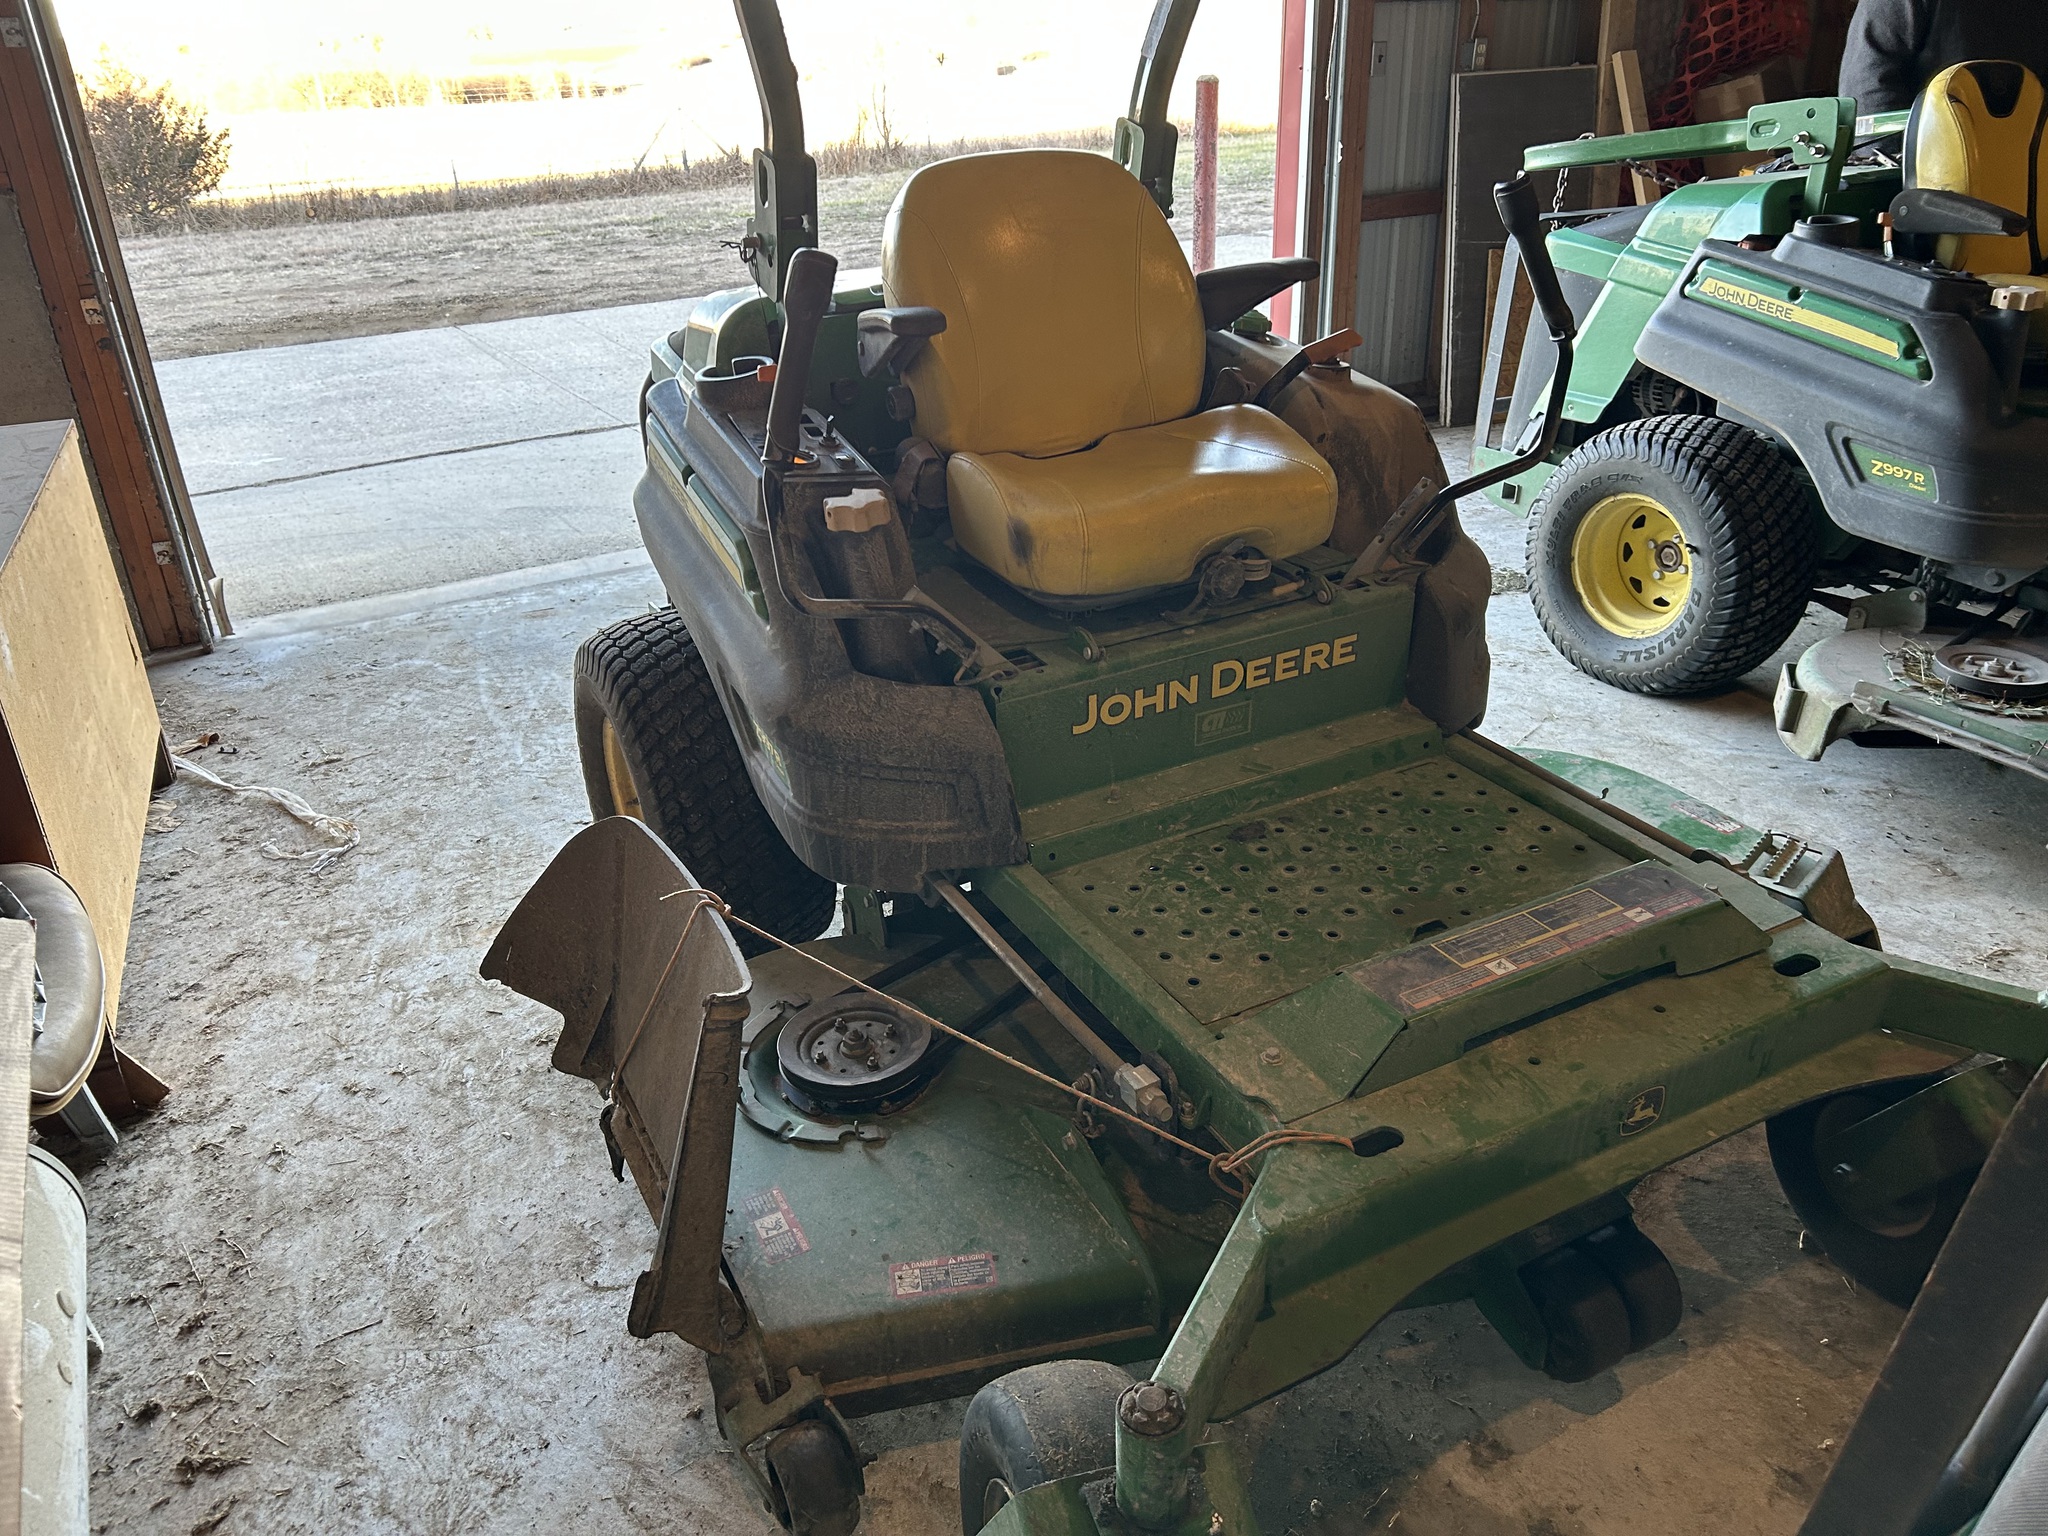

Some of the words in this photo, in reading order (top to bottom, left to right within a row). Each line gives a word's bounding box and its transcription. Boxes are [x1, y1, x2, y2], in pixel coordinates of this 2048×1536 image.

[1708, 281, 1745, 305] JOHN
[1747, 293, 1794, 320] DEERE
[1871, 459, 1925, 485] Z997R
[1546, 511, 1565, 568] MULTI
[1562, 475, 1602, 510] TRAC
[1613, 588, 1702, 663] CARLISLE
[1072, 674, 1199, 735] JOHN
[1211, 633, 1359, 699] DEERE
[911, 1260, 938, 1268] DANGER
[957, 1253, 985, 1262] PELIGRO
